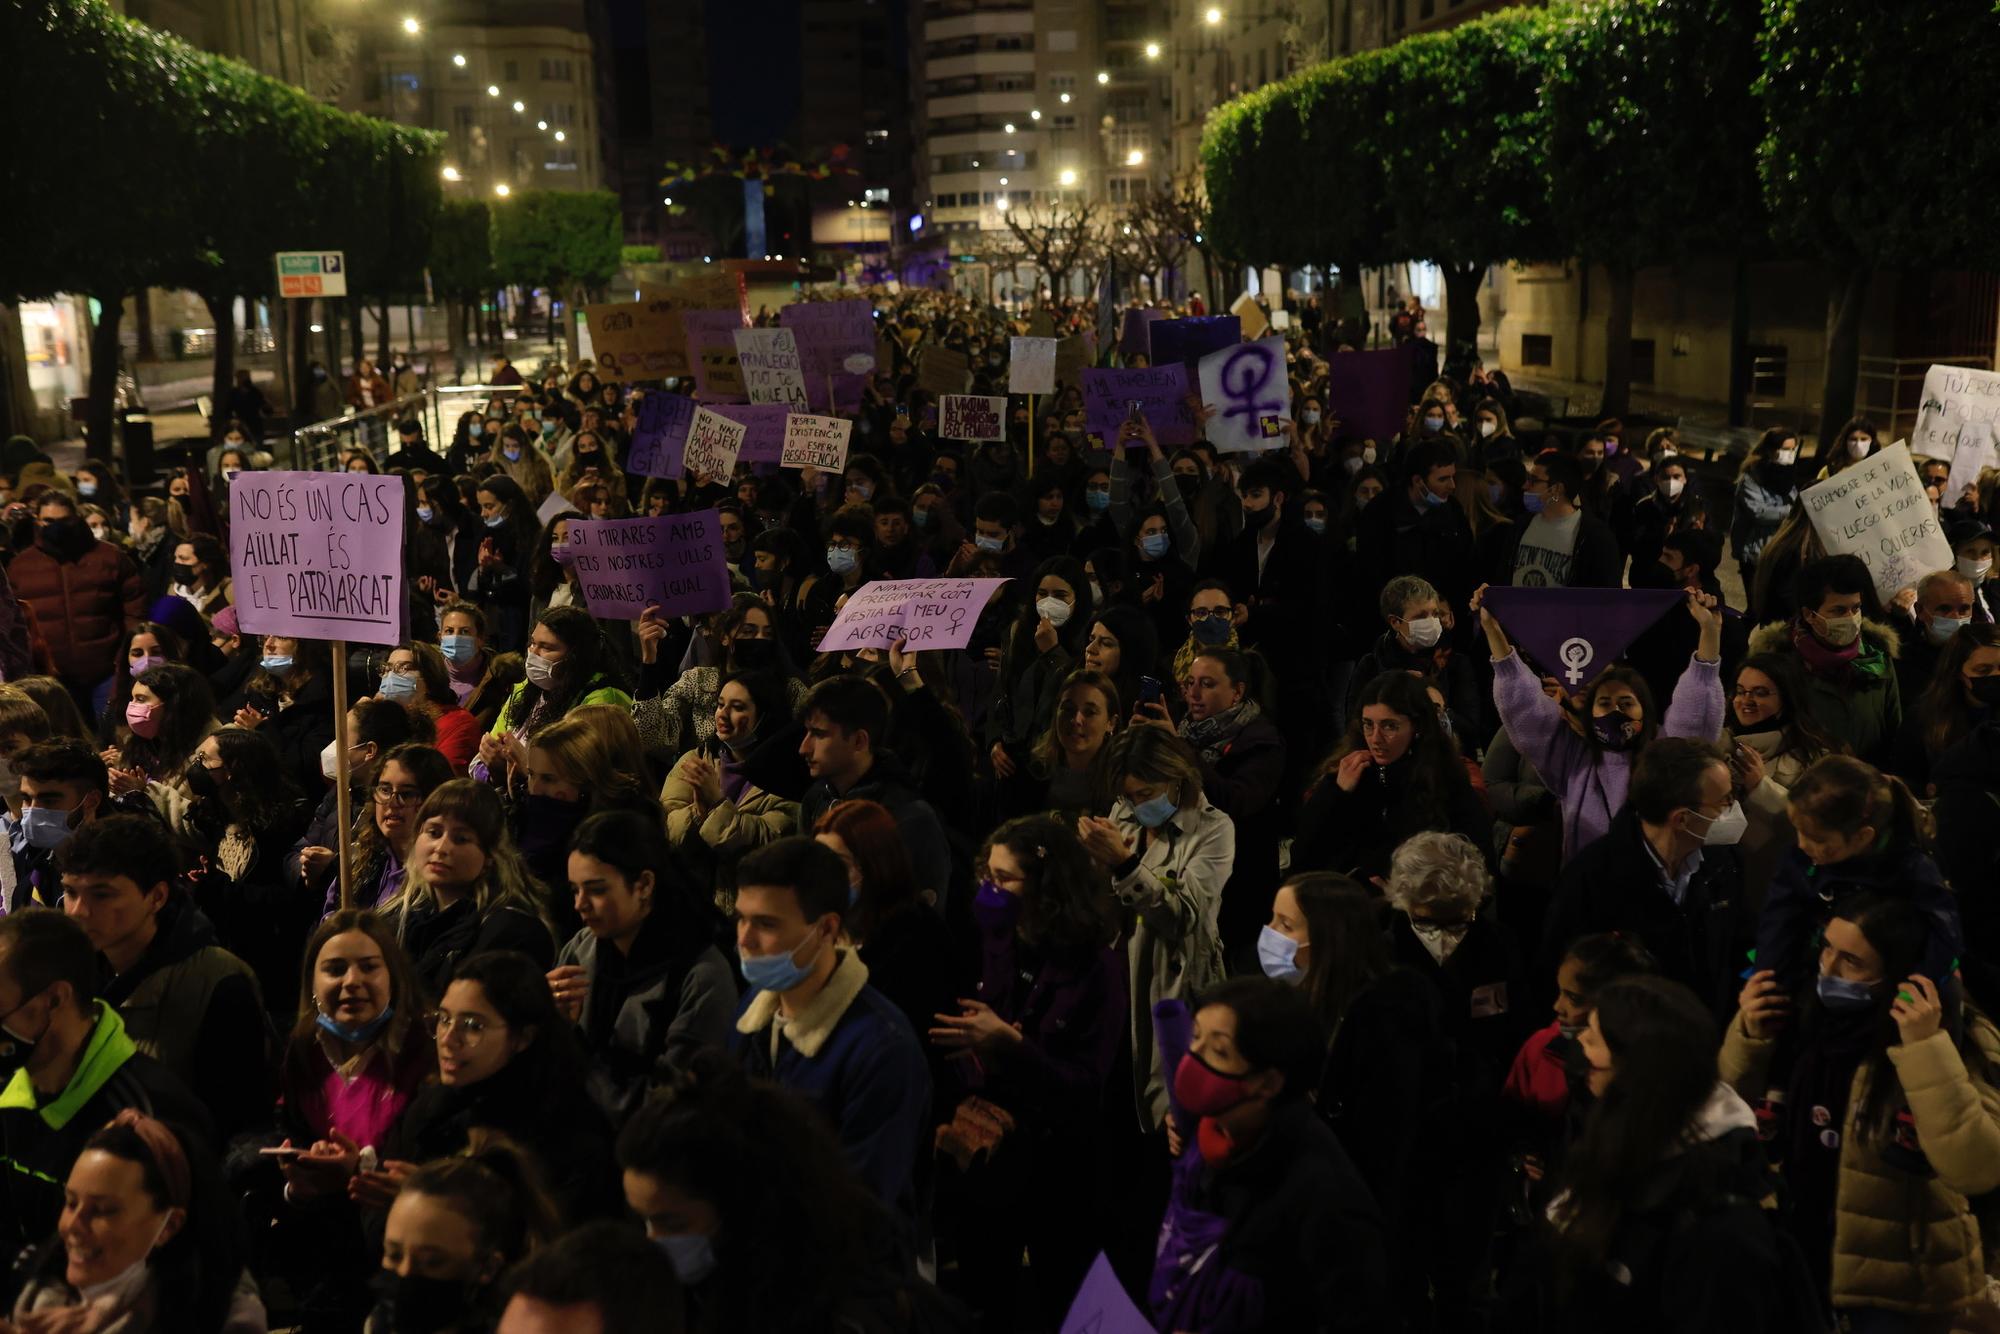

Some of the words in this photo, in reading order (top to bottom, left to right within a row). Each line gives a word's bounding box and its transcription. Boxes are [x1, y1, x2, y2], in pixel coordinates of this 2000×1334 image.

[325, 256, 337, 272] P
[787, 386, 807, 402] LA
[698, 413, 713, 425] NO
[695, 423, 737, 454] MUJER
[790, 428, 843, 439] EXISTENCIA
[687, 446, 725, 473] MORIR
[783, 449, 841, 467] RESISTENCIA
[807, 441, 838, 453] ESPERA
[239, 488, 272, 521] NO
[276, 483, 298, 521] ÉS
[305, 485, 333, 522] UN
[341, 483, 390, 525] CAS
[1854, 494, 1870, 510] DE
[1872, 488, 1885, 501] LA
[1884, 472, 1915, 492] VIDA
[573, 528, 588, 546] SI
[597, 525, 657, 547] MIRARES
[670, 520, 706, 543] AMB
[1843, 513, 1881, 540] LUEGO
[1880, 519, 1938, 557] QUIERAS
[327, 526, 351, 570] ÉS
[577, 555, 600, 572] ELS
[607, 552, 665, 571] NOSTRES
[677, 544, 713, 567] ULLS
[250, 574, 279, 610] EL
[287, 570, 393, 616] PATRIARCAT
[662, 575, 706, 600] IGUAL
[859, 590, 936, 606] PREGUNTAR
[941, 590, 972, 600] COM
[844, 607, 884, 624] VESTIA
[888, 604, 905, 617] EL
[914, 603, 949, 618] MEU
[846, 624, 934, 642] AGRESOR
